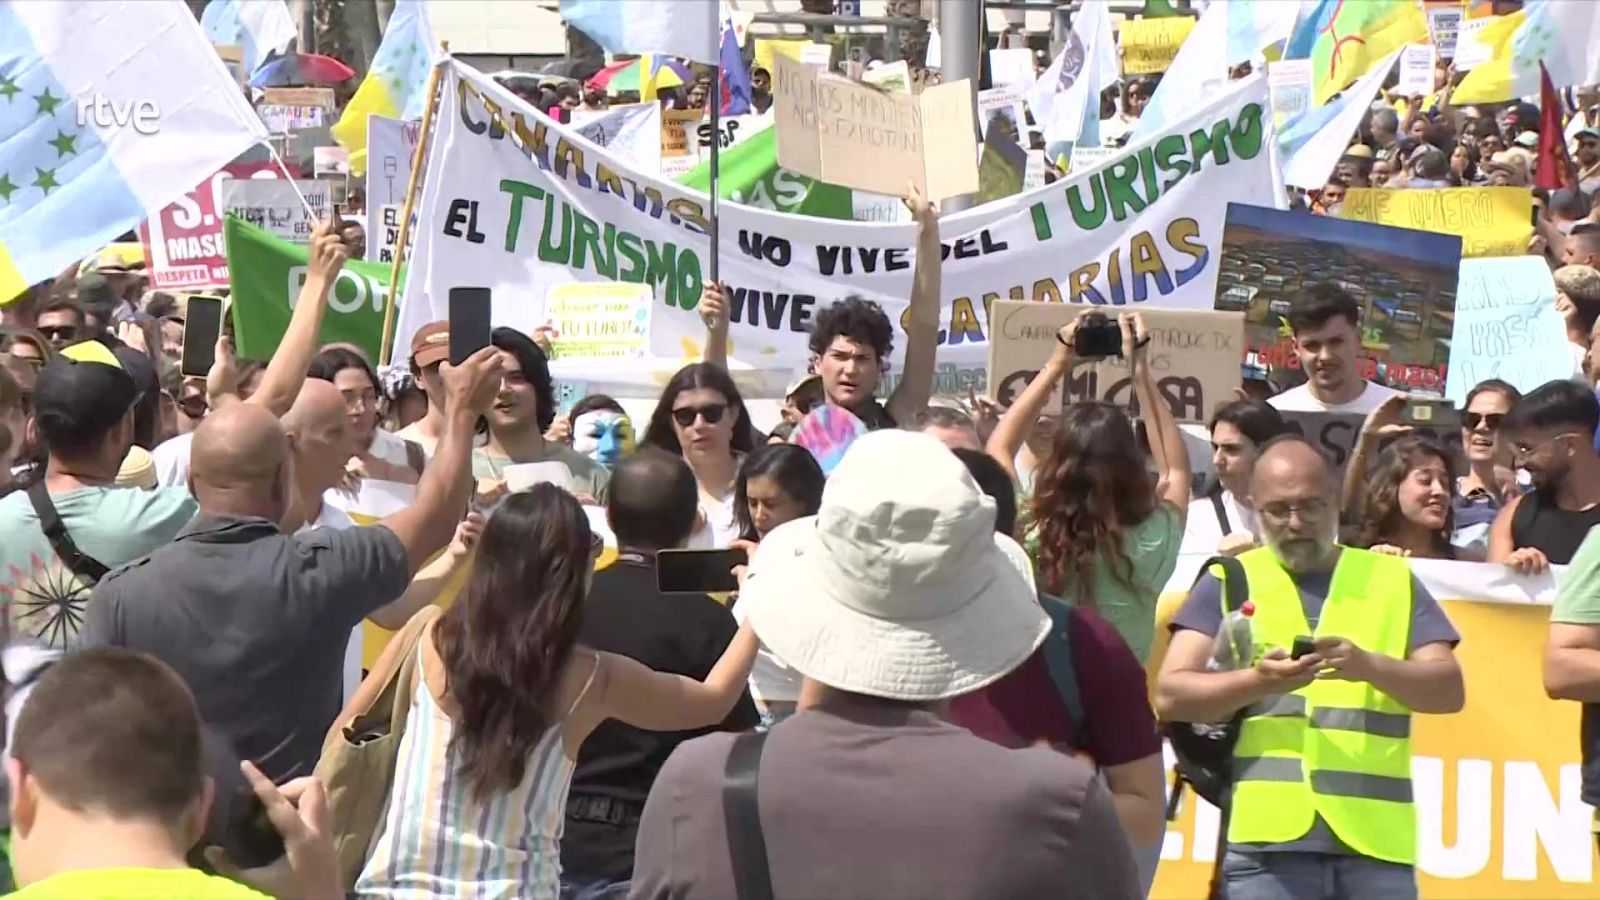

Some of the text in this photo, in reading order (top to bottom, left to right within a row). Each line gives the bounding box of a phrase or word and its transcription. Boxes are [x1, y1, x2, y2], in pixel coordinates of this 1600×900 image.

[442, 198, 487, 244] EL
[498, 178, 703, 312] TURISMO
[815, 245, 910, 276] VIVE
